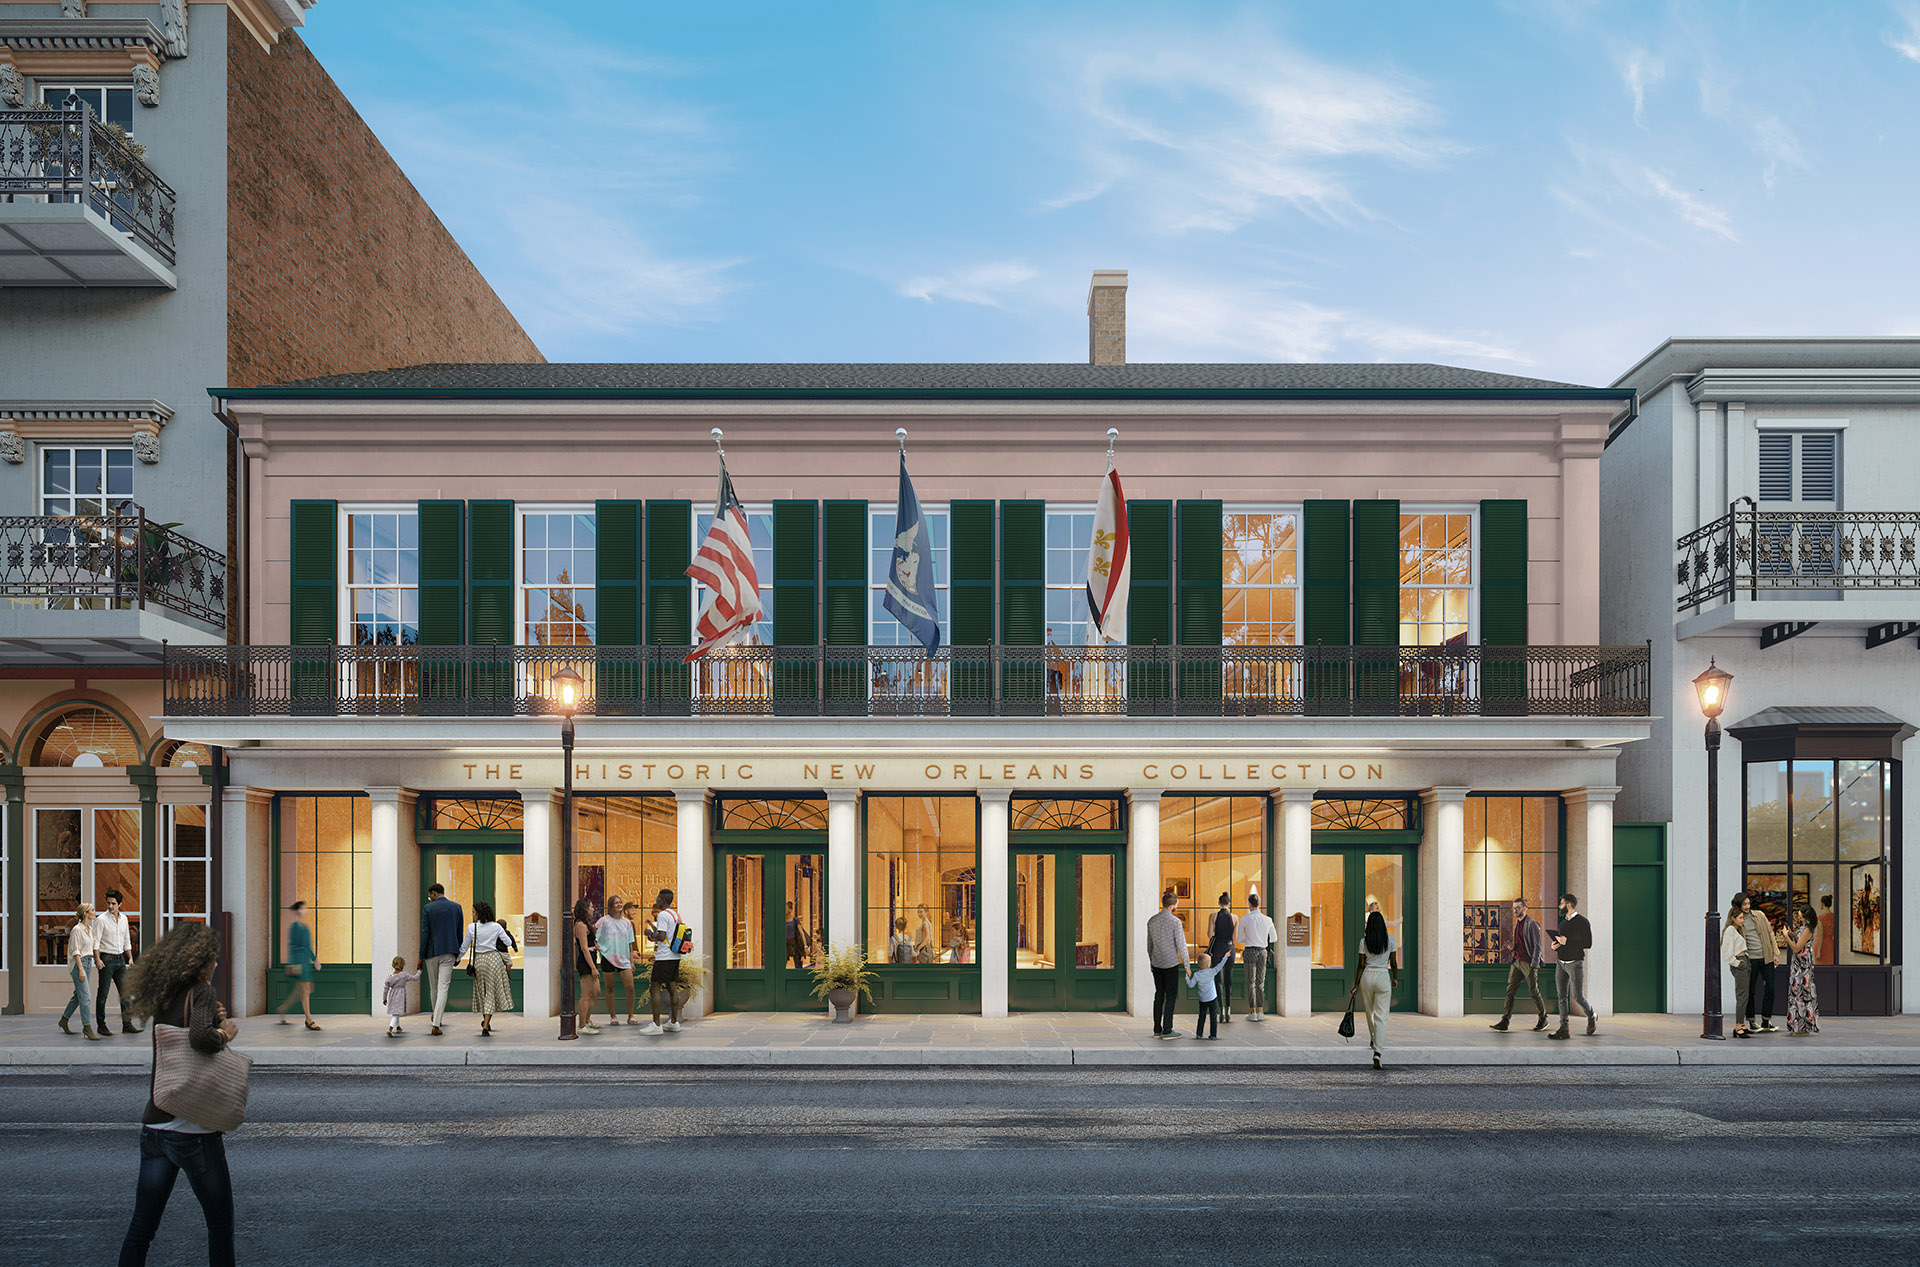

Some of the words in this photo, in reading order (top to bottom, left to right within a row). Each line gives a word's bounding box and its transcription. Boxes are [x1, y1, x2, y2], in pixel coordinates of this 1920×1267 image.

[463, 763, 523, 779] THE
[575, 763, 753, 779] HISTORIC
[803, 764, 875, 779] NEW
[924, 763, 1094, 779] ORLEANS
[1143, 763, 1382, 779] COLLECTION
[617, 874, 641, 886] The
[645, 873, 677, 886] Histo
